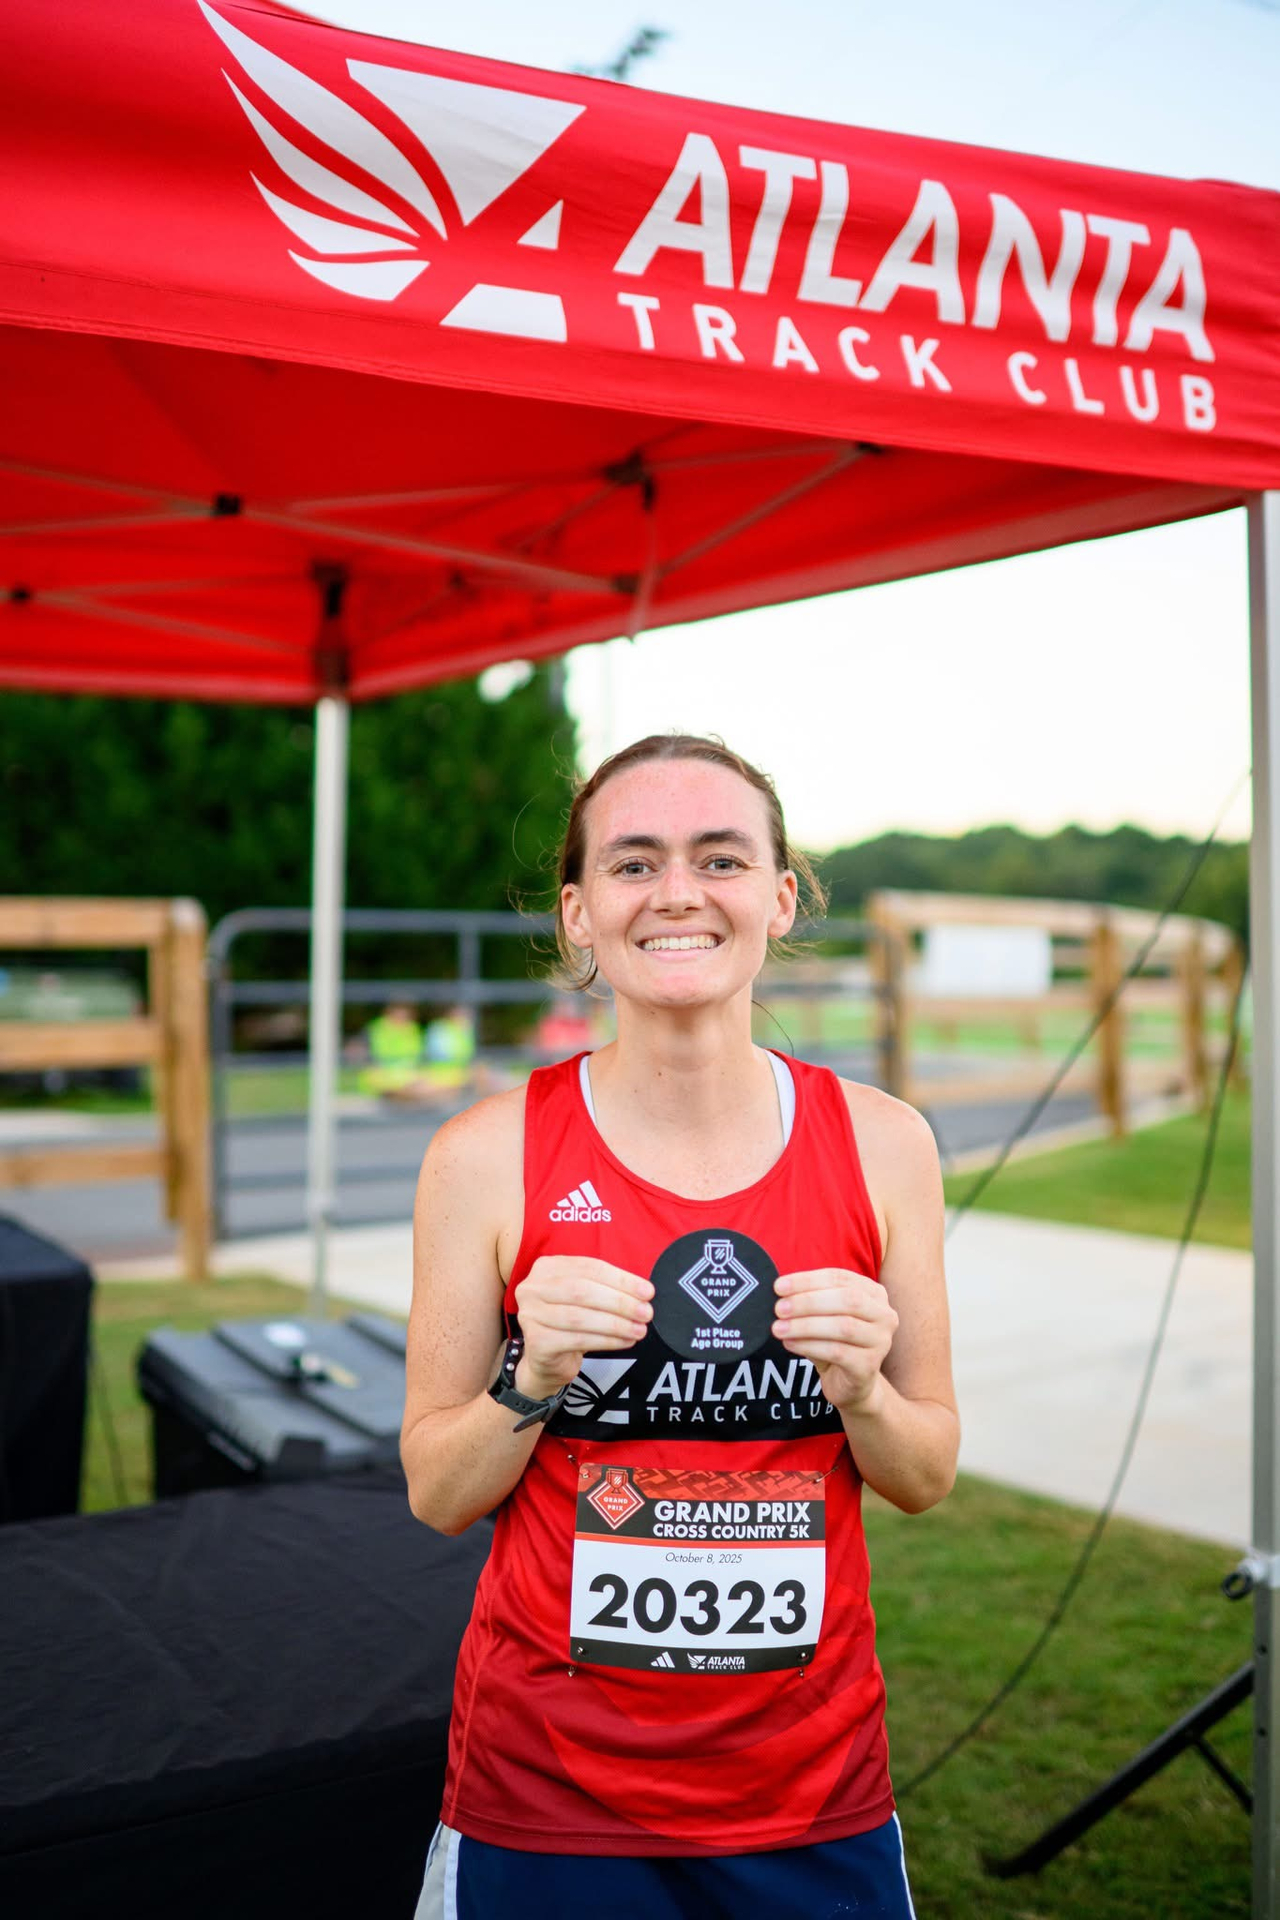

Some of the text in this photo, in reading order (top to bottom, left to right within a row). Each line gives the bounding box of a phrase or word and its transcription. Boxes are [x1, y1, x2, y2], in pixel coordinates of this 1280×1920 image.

[613, 132, 1215, 362] ATLANTA
[617, 292, 1216, 432] TRACK CLUB
[548, 1206, 612, 1223] adidas
[701, 1278, 737, 1287] GRAND
[707, 1288, 731, 1297] PRIX
[695, 1327, 741, 1338] 1st Place
[691, 1338, 744, 1351] Age Group
[646, 1359, 822, 1402] ATLANT
[646, 1402, 834, 1422] TRACK CLUB
[603, 1496, 628, 1505] GRAND
[607, 1504, 624, 1512] PRIX
[654, 1501, 811, 1523] GRAND PRIX
[653, 1523, 810, 1539] CROSS COUNTRY 5K
[665, 1552, 743, 1565] October 8, 2025
[587, 1573, 807, 1636] 20323
[707, 1656, 745, 1666] ATLANTA
